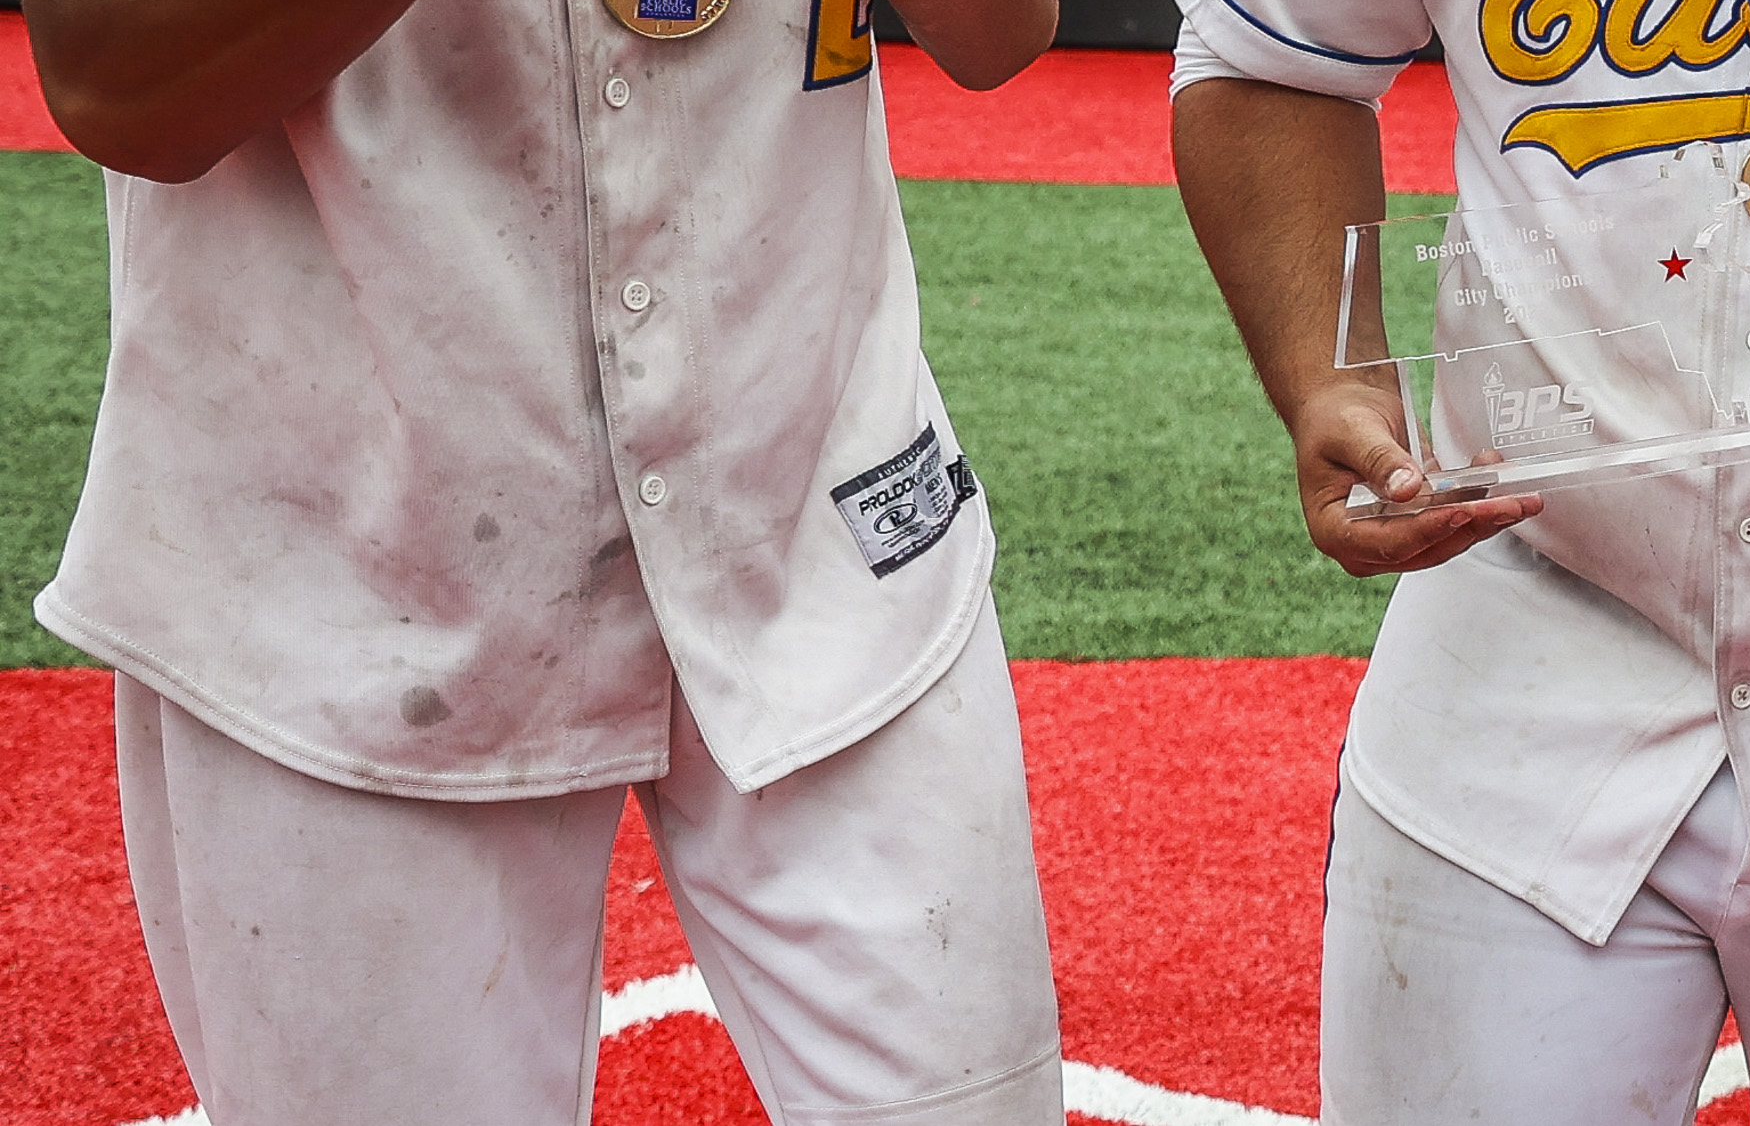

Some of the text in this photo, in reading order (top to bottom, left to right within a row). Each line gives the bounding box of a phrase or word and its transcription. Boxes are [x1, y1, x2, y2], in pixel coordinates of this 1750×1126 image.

[640, 2, 693, 14] SCHOOLS
[1414, 238, 1477, 263] Boston
[1454, 286, 1488, 307] City
[1497, 382, 1593, 433] BPS
